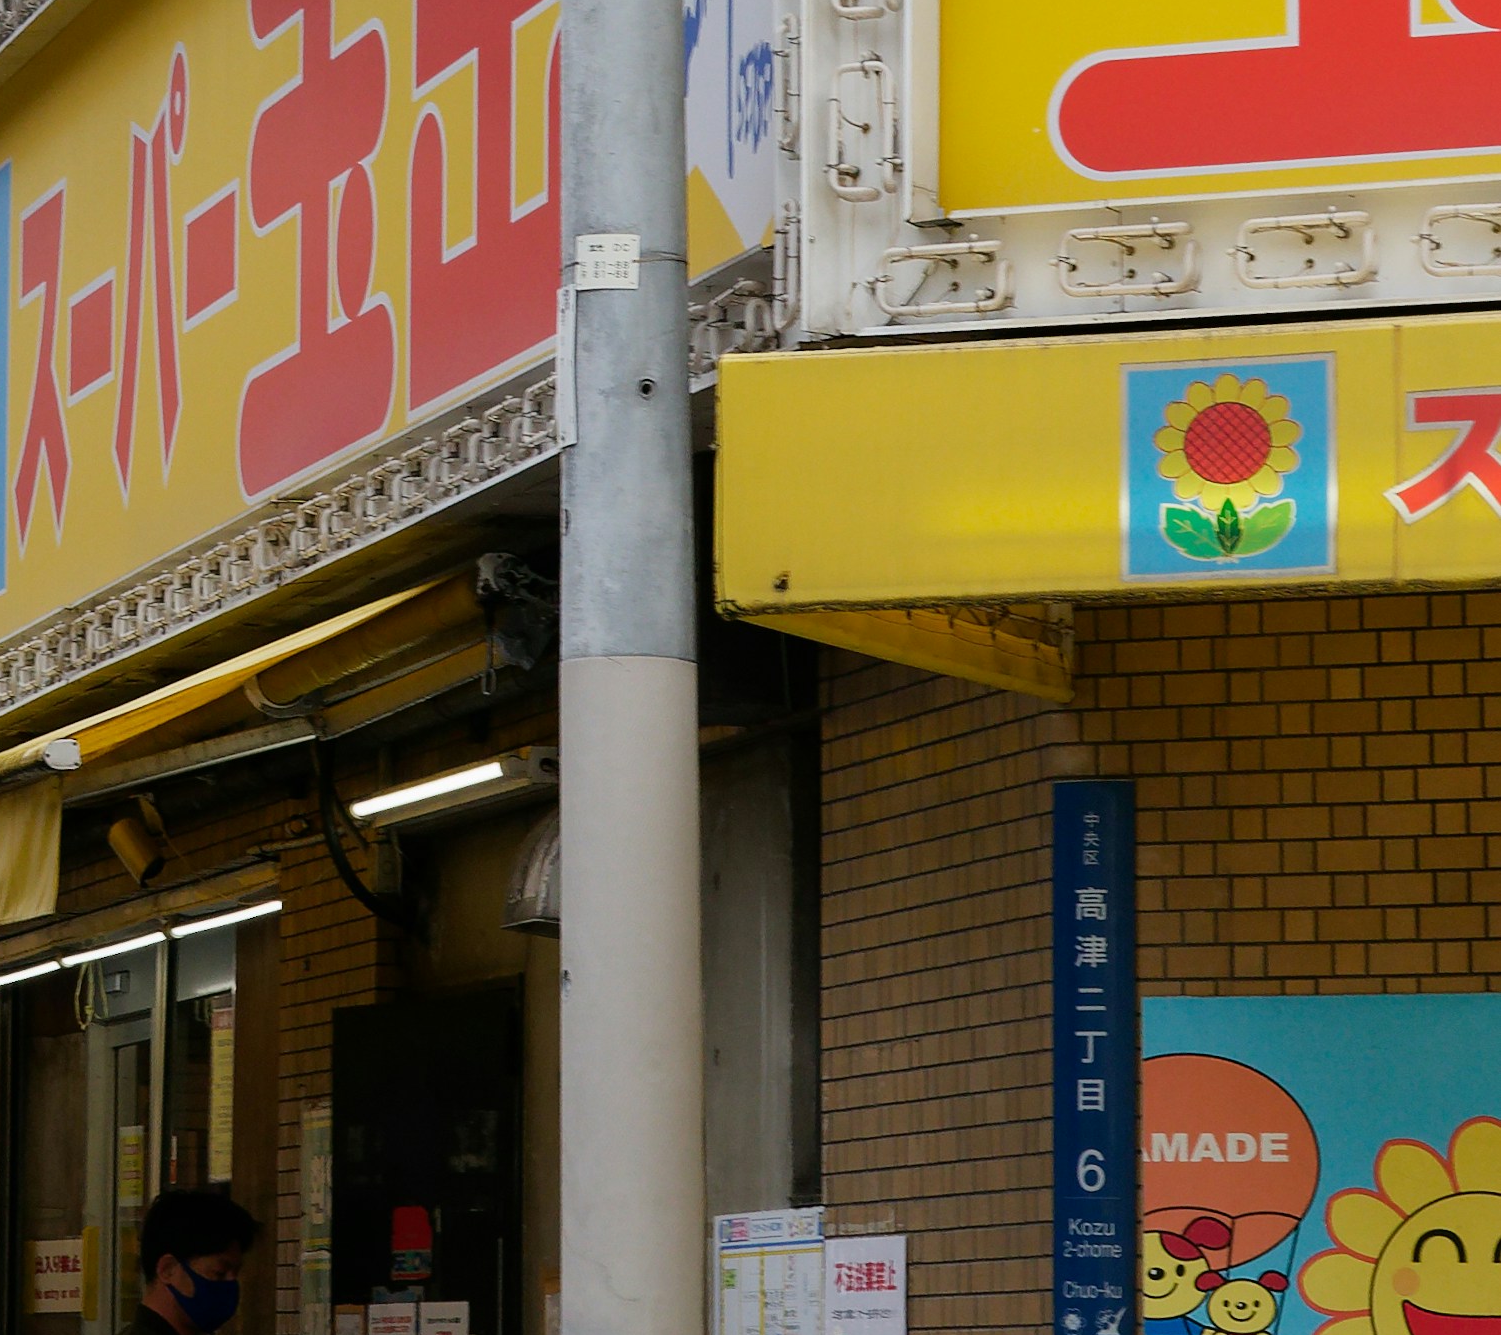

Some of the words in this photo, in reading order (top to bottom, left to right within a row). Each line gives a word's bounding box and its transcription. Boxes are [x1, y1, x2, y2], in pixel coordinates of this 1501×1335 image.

[1082, 812, 1100, 866] 中央区
[1074, 886, 1109, 1113] 高津二丁目
[1142, 1132, 1290, 1163] MADE
[1076, 1148, 1107, 1193] 6
[1068, 1218, 1116, 1237] Kozu
[1062, 1241, 1123, 1259] 2-chome
[834, 1260, 897, 1293] 不法投棄禁止
[1062, 1280, 1124, 1299] Chuo-ku
